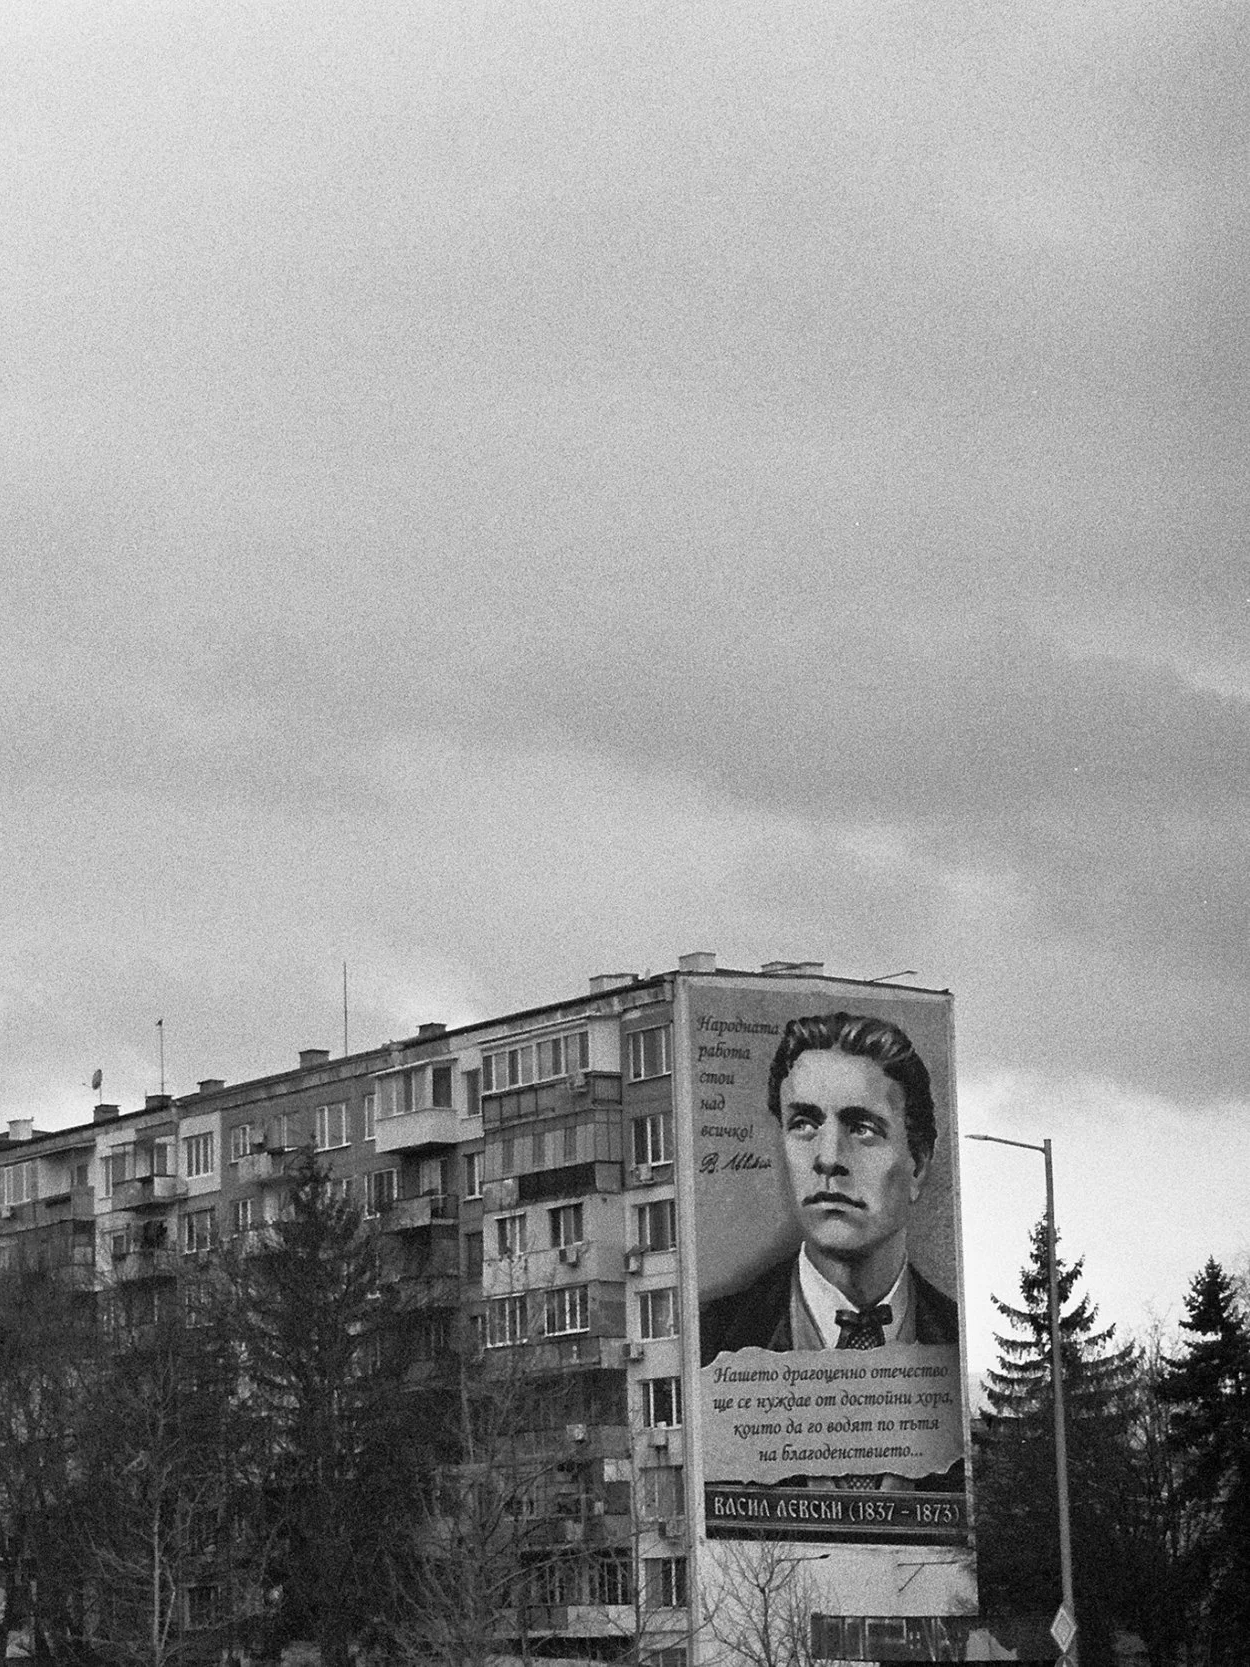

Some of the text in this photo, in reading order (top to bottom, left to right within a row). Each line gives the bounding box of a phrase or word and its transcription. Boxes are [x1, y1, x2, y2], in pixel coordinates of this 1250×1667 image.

[696, 1015, 778, 1036] Народната
[698, 1042, 750, 1061] работа
[699, 1072, 735, 1084] стои
[701, 1093, 725, 1111] над
[701, 1124, 753, 1142] всичко!
[714, 1365, 948, 1386] Нашето драгоценно отечество
[713, 1398, 734, 1413] ще
[738, 1398, 751, 1409] се
[757, 1391, 811, 1413] нуждае
[815, 1395, 836, 1406] от
[841, 1389, 912, 1406] достойни
[734, 1416, 939, 1439] които да го водят по пътя
[759, 1450, 777, 1461] на
[714, 1496, 769, 1517] ВАСИЛ
[777, 1500, 842, 1519] ЛЕВСКИ
[849, 1503, 895, 1521] (1837
[916, 1504, 960, 1523] 1873)
